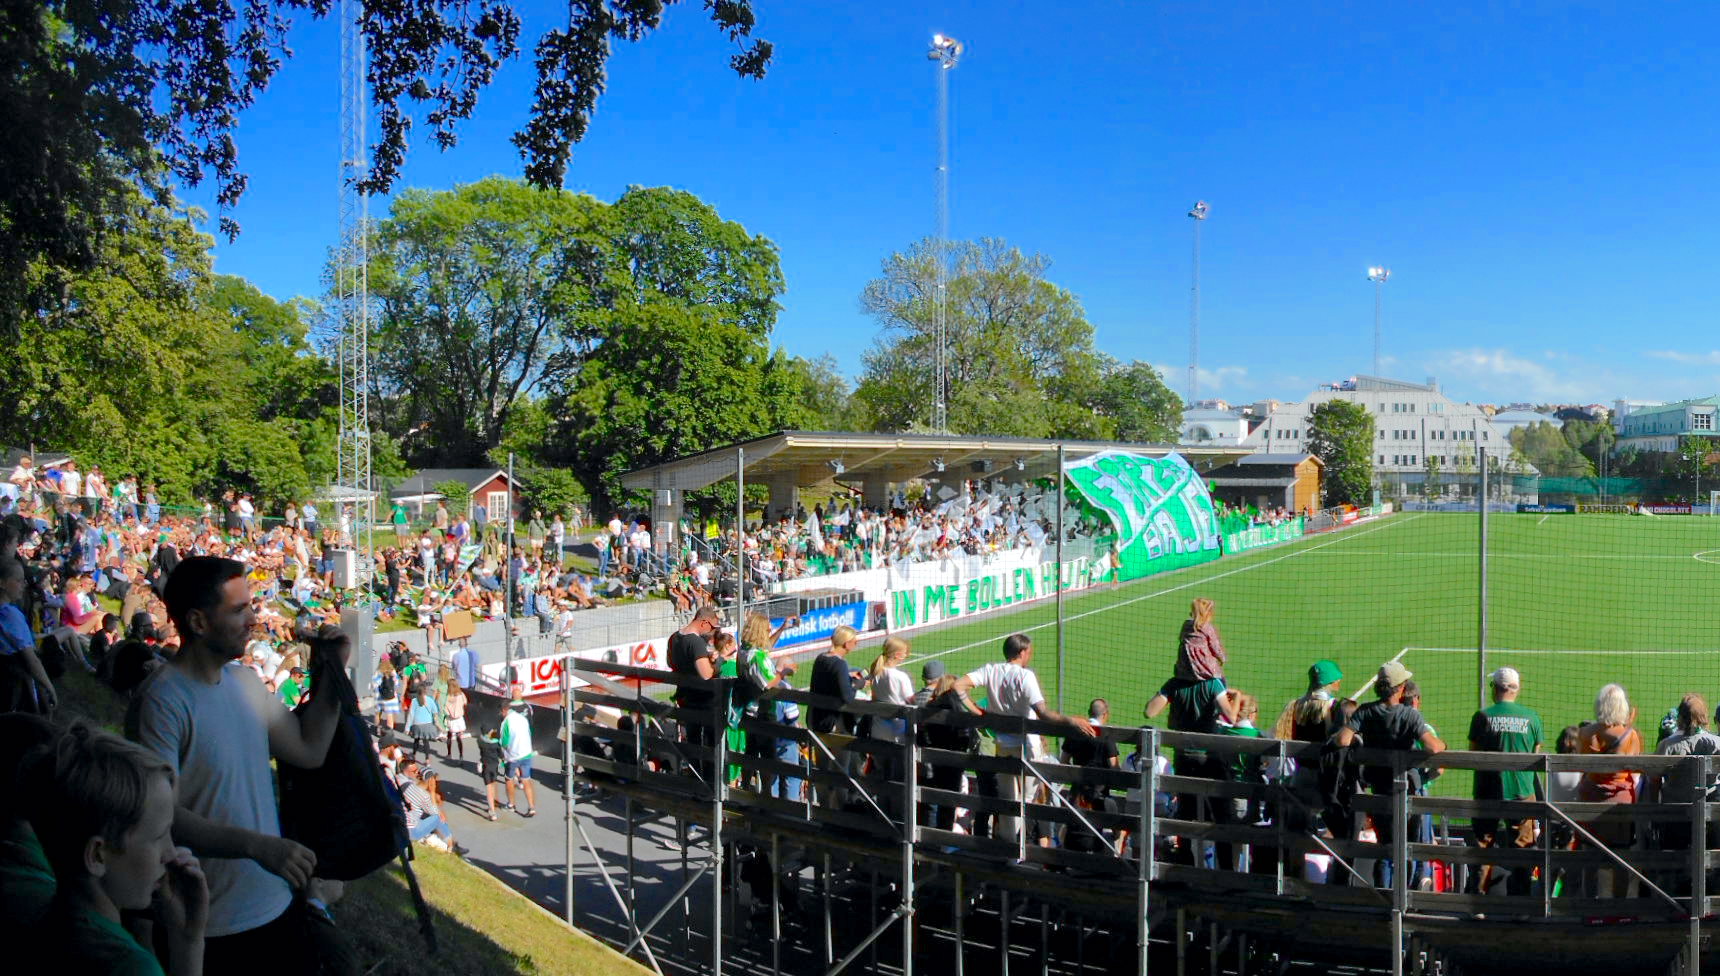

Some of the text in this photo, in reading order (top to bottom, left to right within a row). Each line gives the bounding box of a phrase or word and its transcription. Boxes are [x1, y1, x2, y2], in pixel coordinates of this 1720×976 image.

[892, 589, 917, 627] IN
[923, 584, 961, 623] ME
[629, 643, 657, 666] ICA
[530, 659, 562, 683] ICA
[1488, 723, 1529, 734] TOCKHOLM
